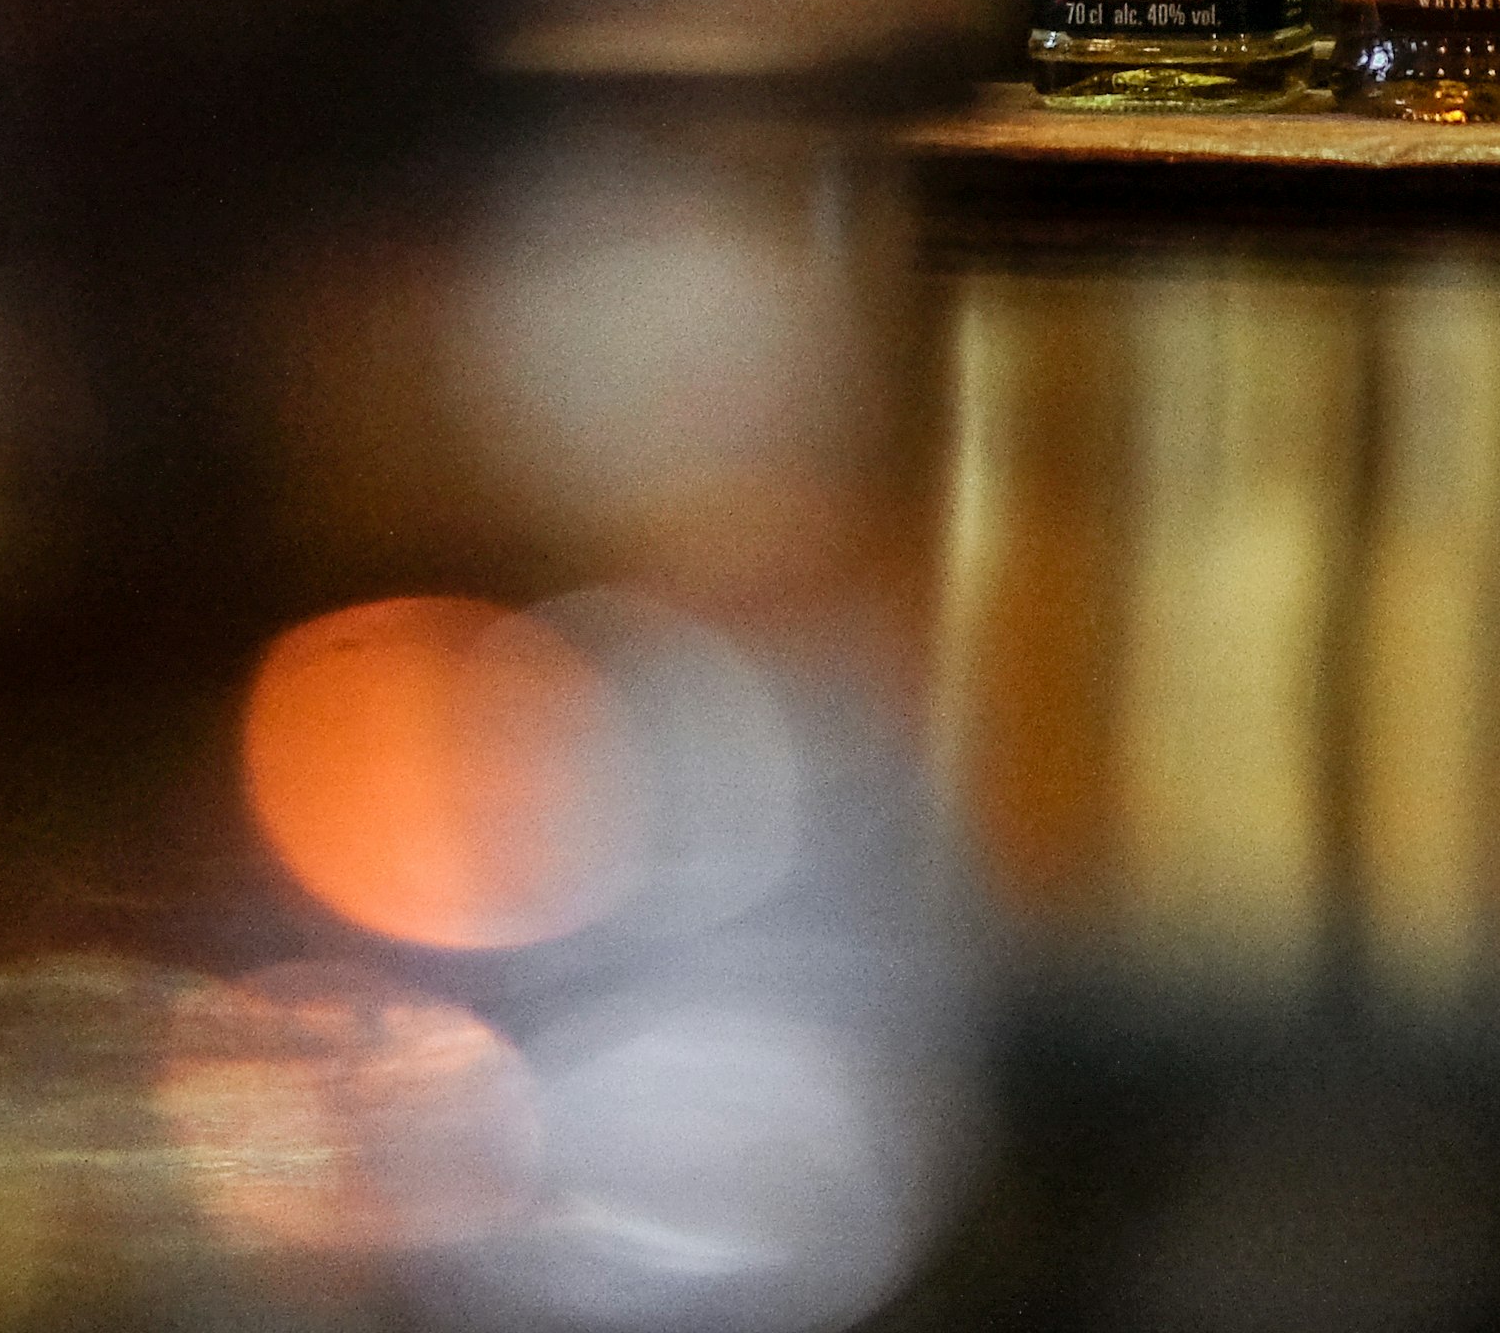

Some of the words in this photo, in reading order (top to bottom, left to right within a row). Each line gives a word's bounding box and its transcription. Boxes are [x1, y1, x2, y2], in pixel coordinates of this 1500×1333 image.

[1065, 2, 1086, 25] 70
[1088, 2, 1104, 25] cl
[1114, 3, 1143, 26] alc.
[1147, 2, 1186, 26] 40%
[1191, 4, 1222, 26] vol.
